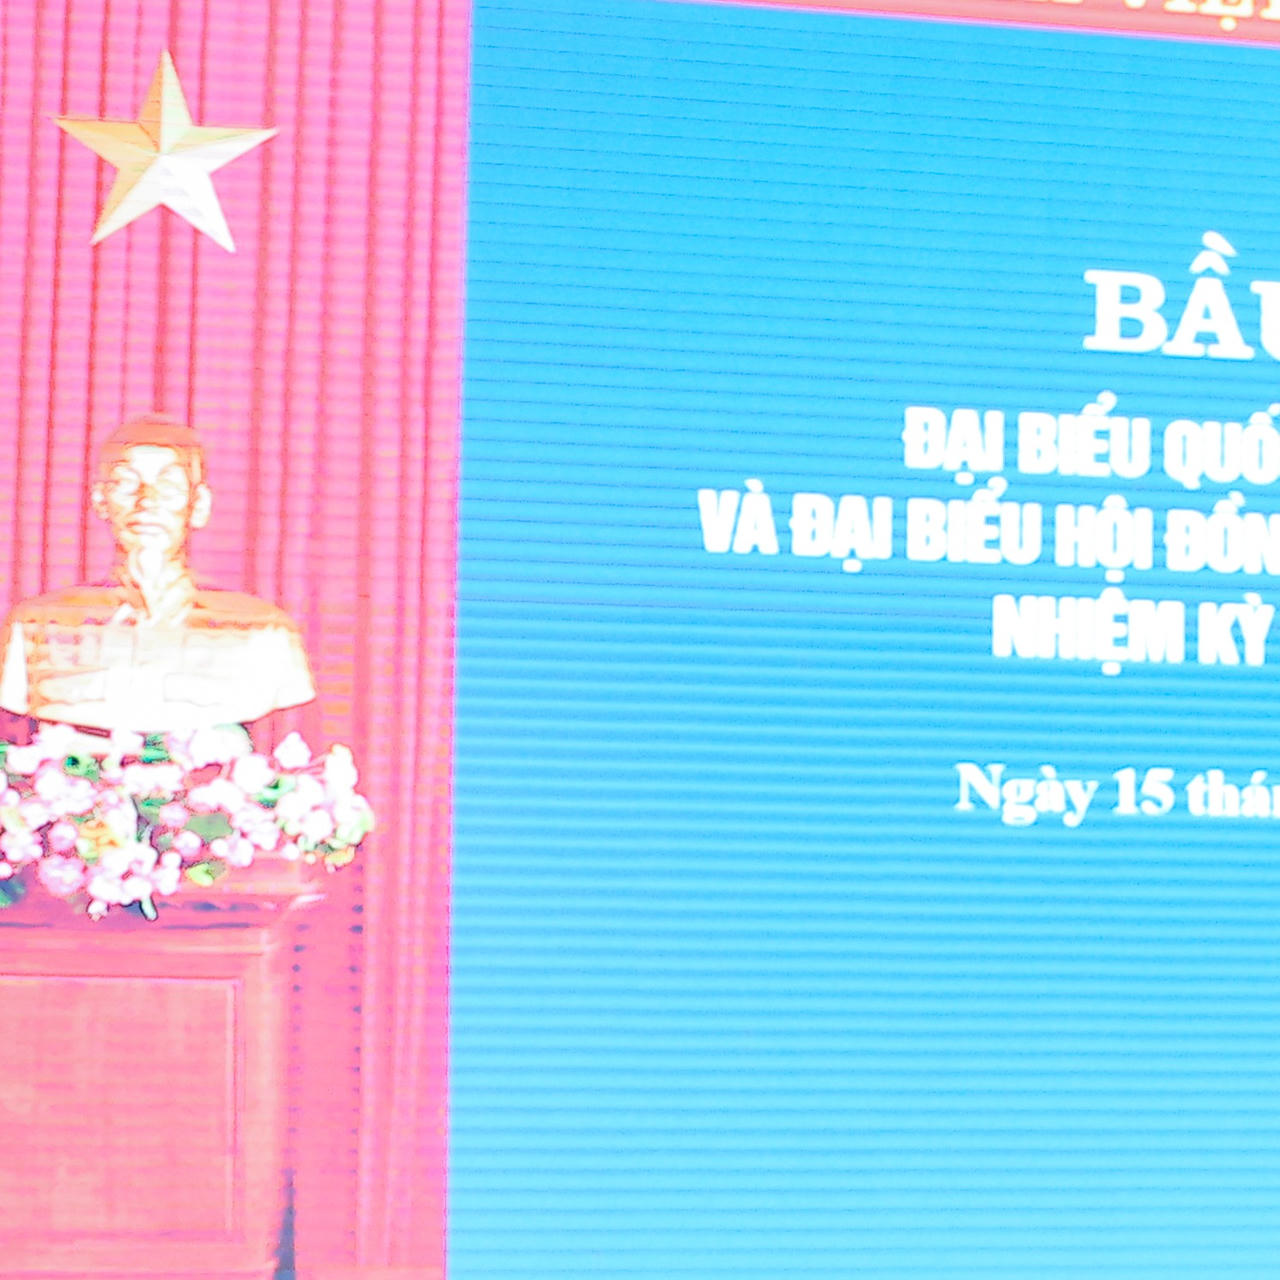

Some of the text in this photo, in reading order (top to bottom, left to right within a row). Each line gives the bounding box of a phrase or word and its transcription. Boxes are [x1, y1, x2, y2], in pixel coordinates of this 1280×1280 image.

[902, 406, 1004, 485] ĐẠI
[1017, 390, 1151, 478] BIỂU
[698, 478, 779, 555] VÀ
[789, 492, 893, 572] ĐẠI
[906, 476, 1042, 565] BIỂU
[1055, 494, 1153, 582] HỘI
[992, 587, 1185, 675] NHIỆM
[1198, 592, 1275, 666] KỲ
[954, 762, 1098, 828] Ngày
[1113, 767, 1175, 816] 15
